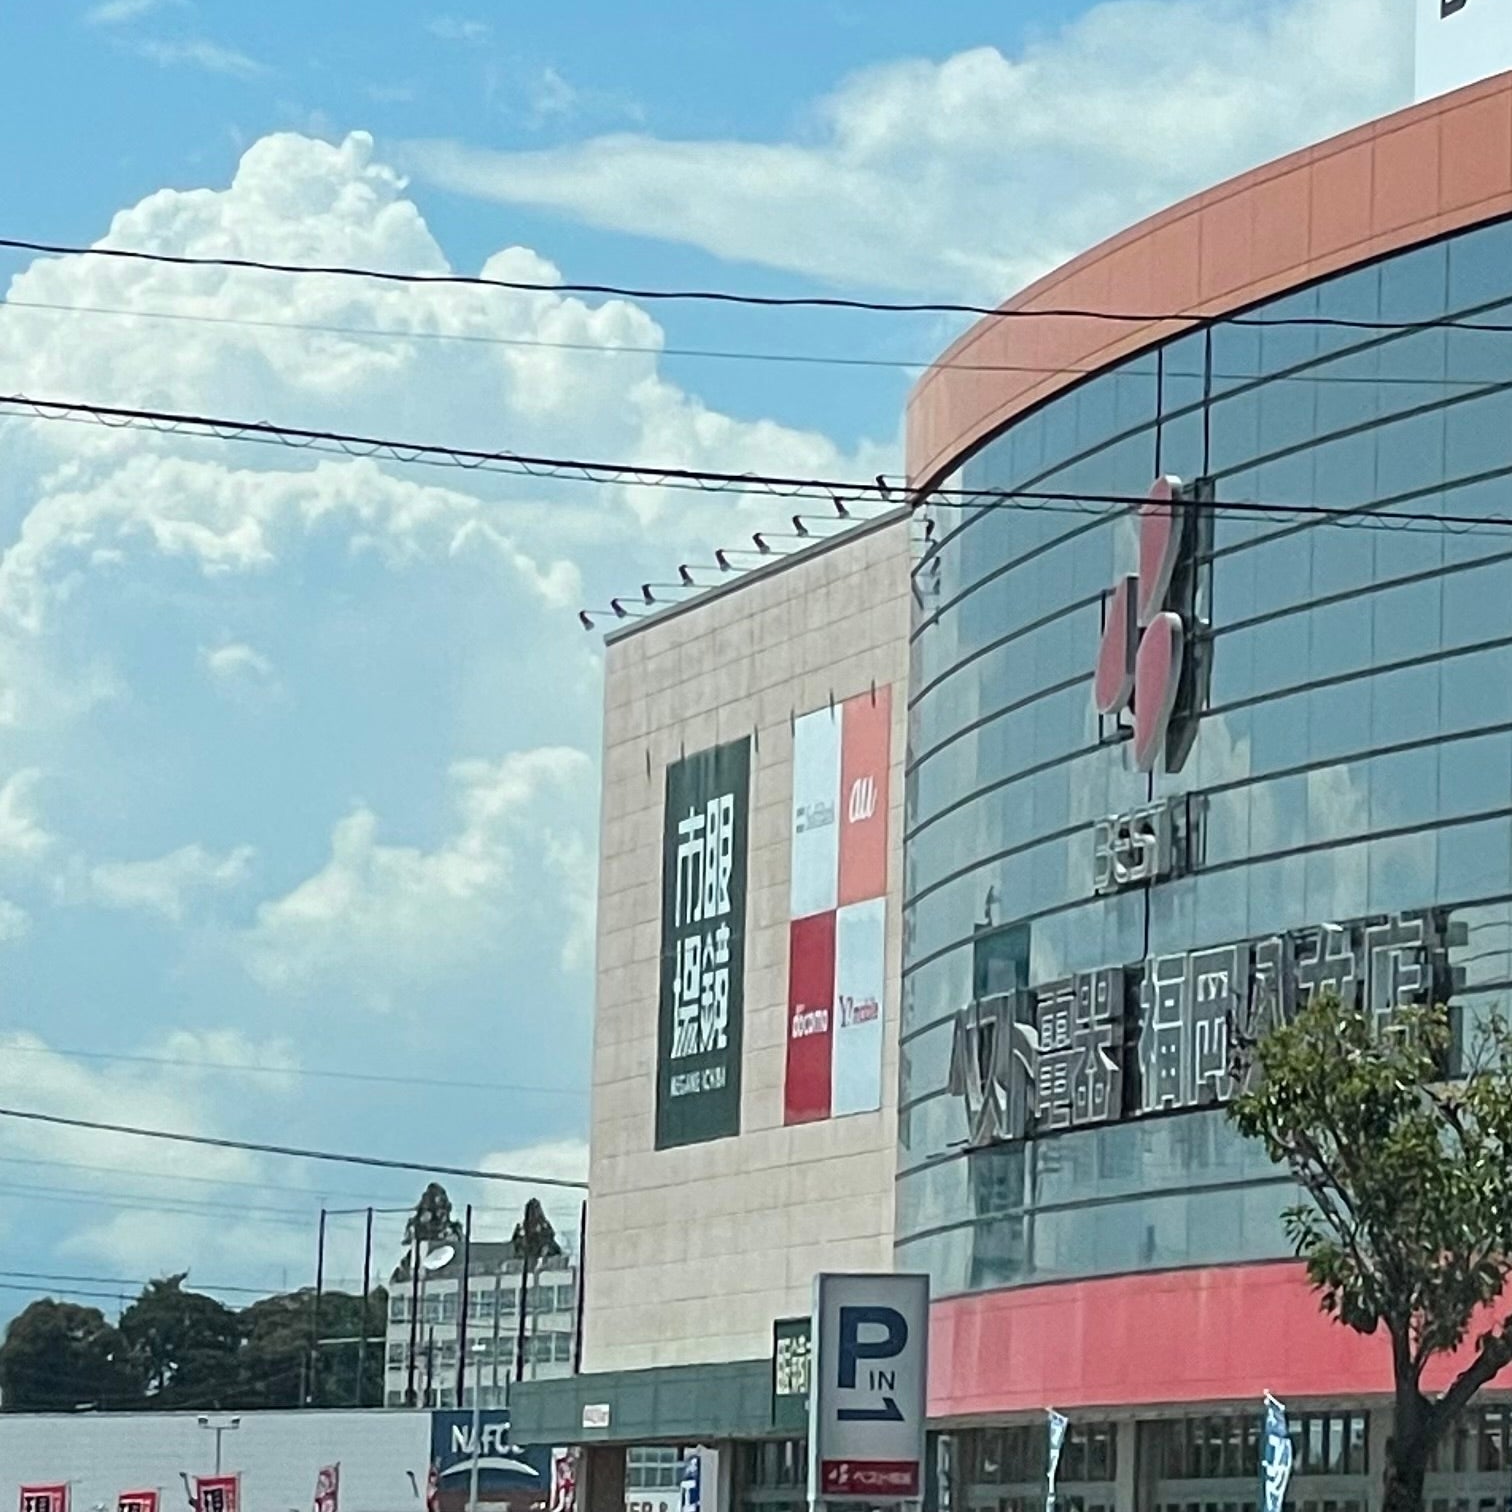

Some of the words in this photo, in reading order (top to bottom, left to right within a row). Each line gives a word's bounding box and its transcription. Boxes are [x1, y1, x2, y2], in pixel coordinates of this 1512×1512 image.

[849, 776, 878, 824] au
[837, 1306, 909, 1388] P
[869, 1370, 895, 1390] IN
